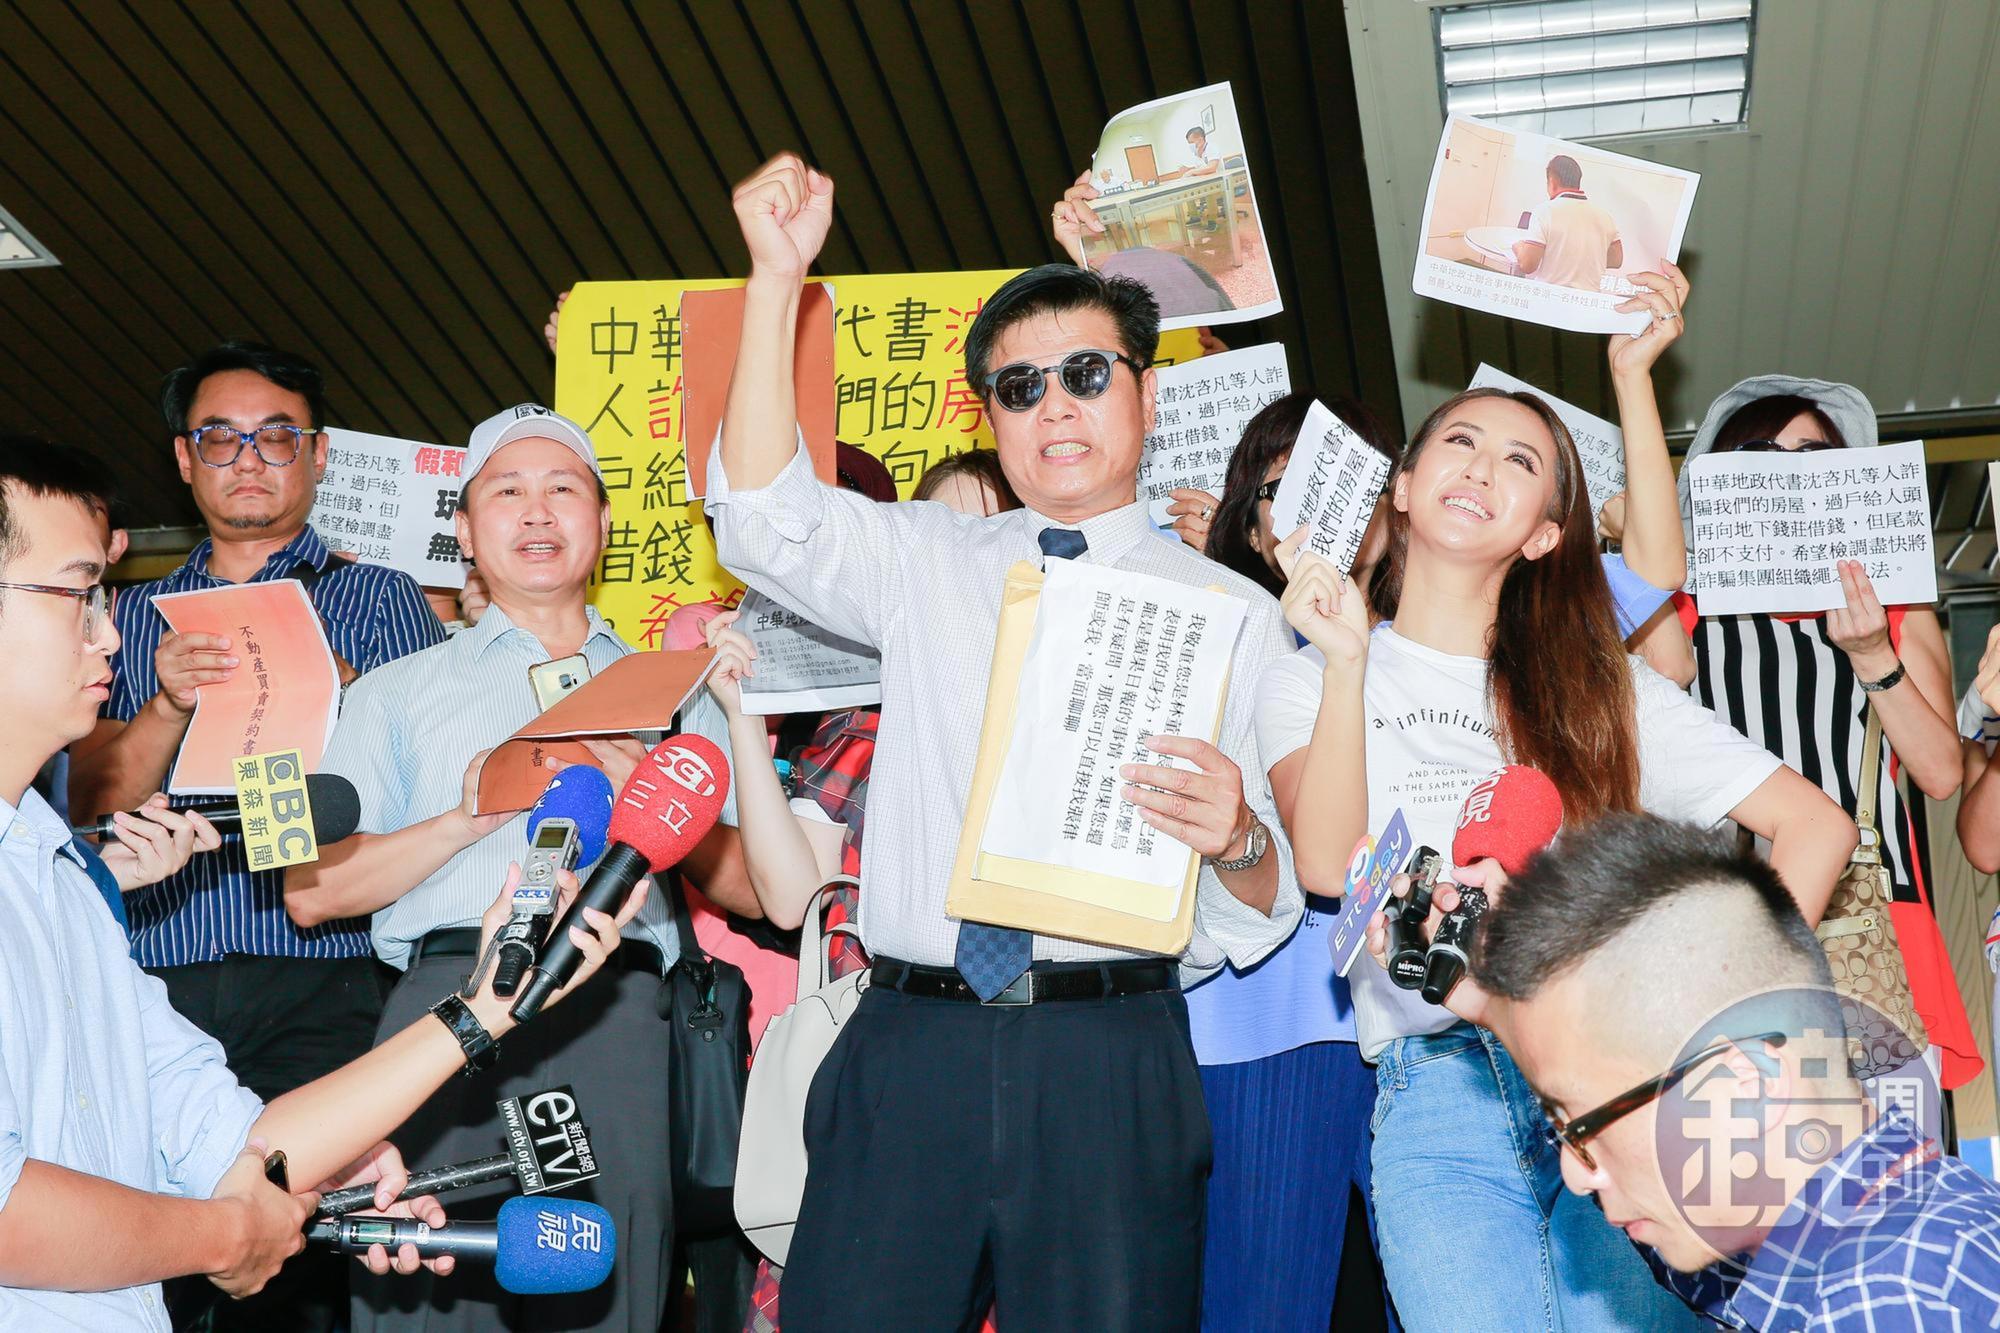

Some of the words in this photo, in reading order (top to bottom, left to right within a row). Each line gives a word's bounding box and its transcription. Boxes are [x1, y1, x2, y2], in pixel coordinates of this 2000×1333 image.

[591, 304, 681, 374] 中華
[323, 470, 402, 497] 屋，過戶給
[328, 447, 405, 475] 書沈咨凡等
[315, 490, 400, 518] 莊借錢，但
[1694, 486, 1922, 517] 騙我們的房屋，過戶給人頭
[1696, 510, 1925, 541] 再向地下錢莊借錢，但尾款
[589, 520, 695, 587] 借錢
[1698, 561, 1903, 590] 詐騙集團組織繩法。
[238, 625, 269, 755] 不動產買賣契約書
[653, 745, 717, 797] SET
[1388, 785, 1400, 793] IN
[1405, 782, 1423, 792] THE
[1429, 780, 1455, 790] SAME
[1408, 770, 1429, 778] AND
[1434, 768, 1468, 777] AGAIN
[238, 760, 274, 867] 東森新聞
[623, 779, 694, 836] 三立
[1334, 829, 1402, 952] ETtoday
[503, 1099, 539, 1188] www.etv.org.tw
[567, 1120, 596, 1173] 新聞網
[537, 1210, 601, 1253] 民視
